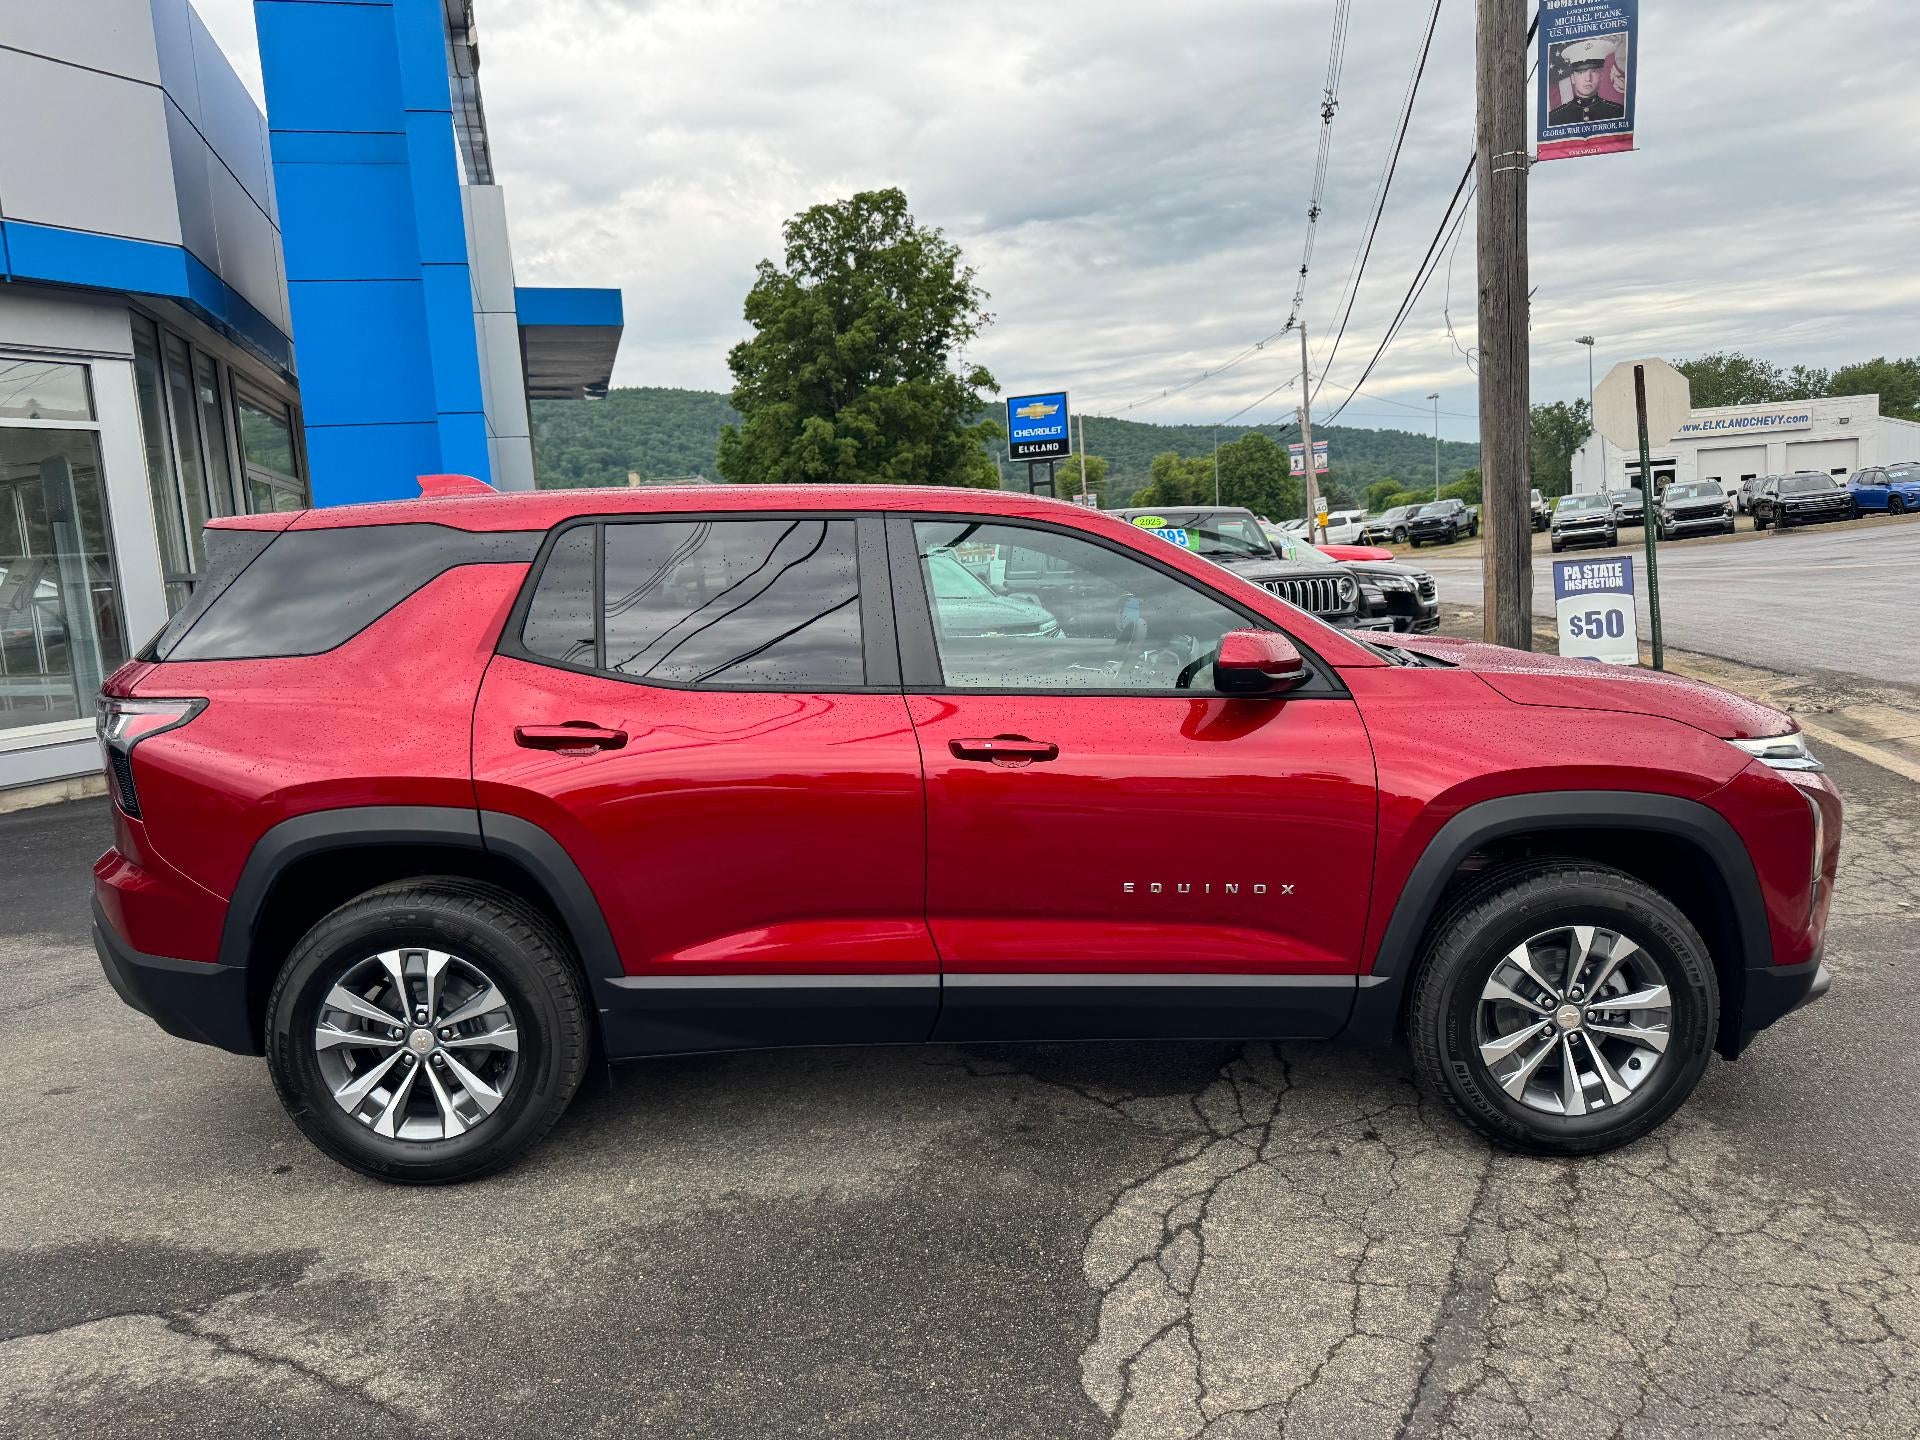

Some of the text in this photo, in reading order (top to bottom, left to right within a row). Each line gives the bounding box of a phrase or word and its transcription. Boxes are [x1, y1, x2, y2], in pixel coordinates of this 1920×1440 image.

[1546, 0, 1601, 10] HOMETO
[1554, 8, 1623, 27] MICHAEL PLANK
[1549, 18, 1628, 38] U.S. MARINE CORPS
[1542, 128, 1567, 137] GLOBAL
[1566, 126, 1581, 135] WAR
[1581, 125, 1591, 133] ON
[1013, 425, 1063, 438] CHEVROLET
[1679, 414, 1809, 433] ww.ELKLANDCHEVY.com
[1018, 442, 1060, 454] ELKLAND
[1139, 518, 1162, 527] 2025
[1563, 562, 1623, 580] PA STATE
[1564, 576, 1624, 591] INSPECTION
[1569, 608, 1625, 640] $50
[1123, 882, 1295, 895] EQUINOX
[1652, 920, 1702, 985] MICHELIN
[1453, 1063, 1504, 1121] MICHELIN
